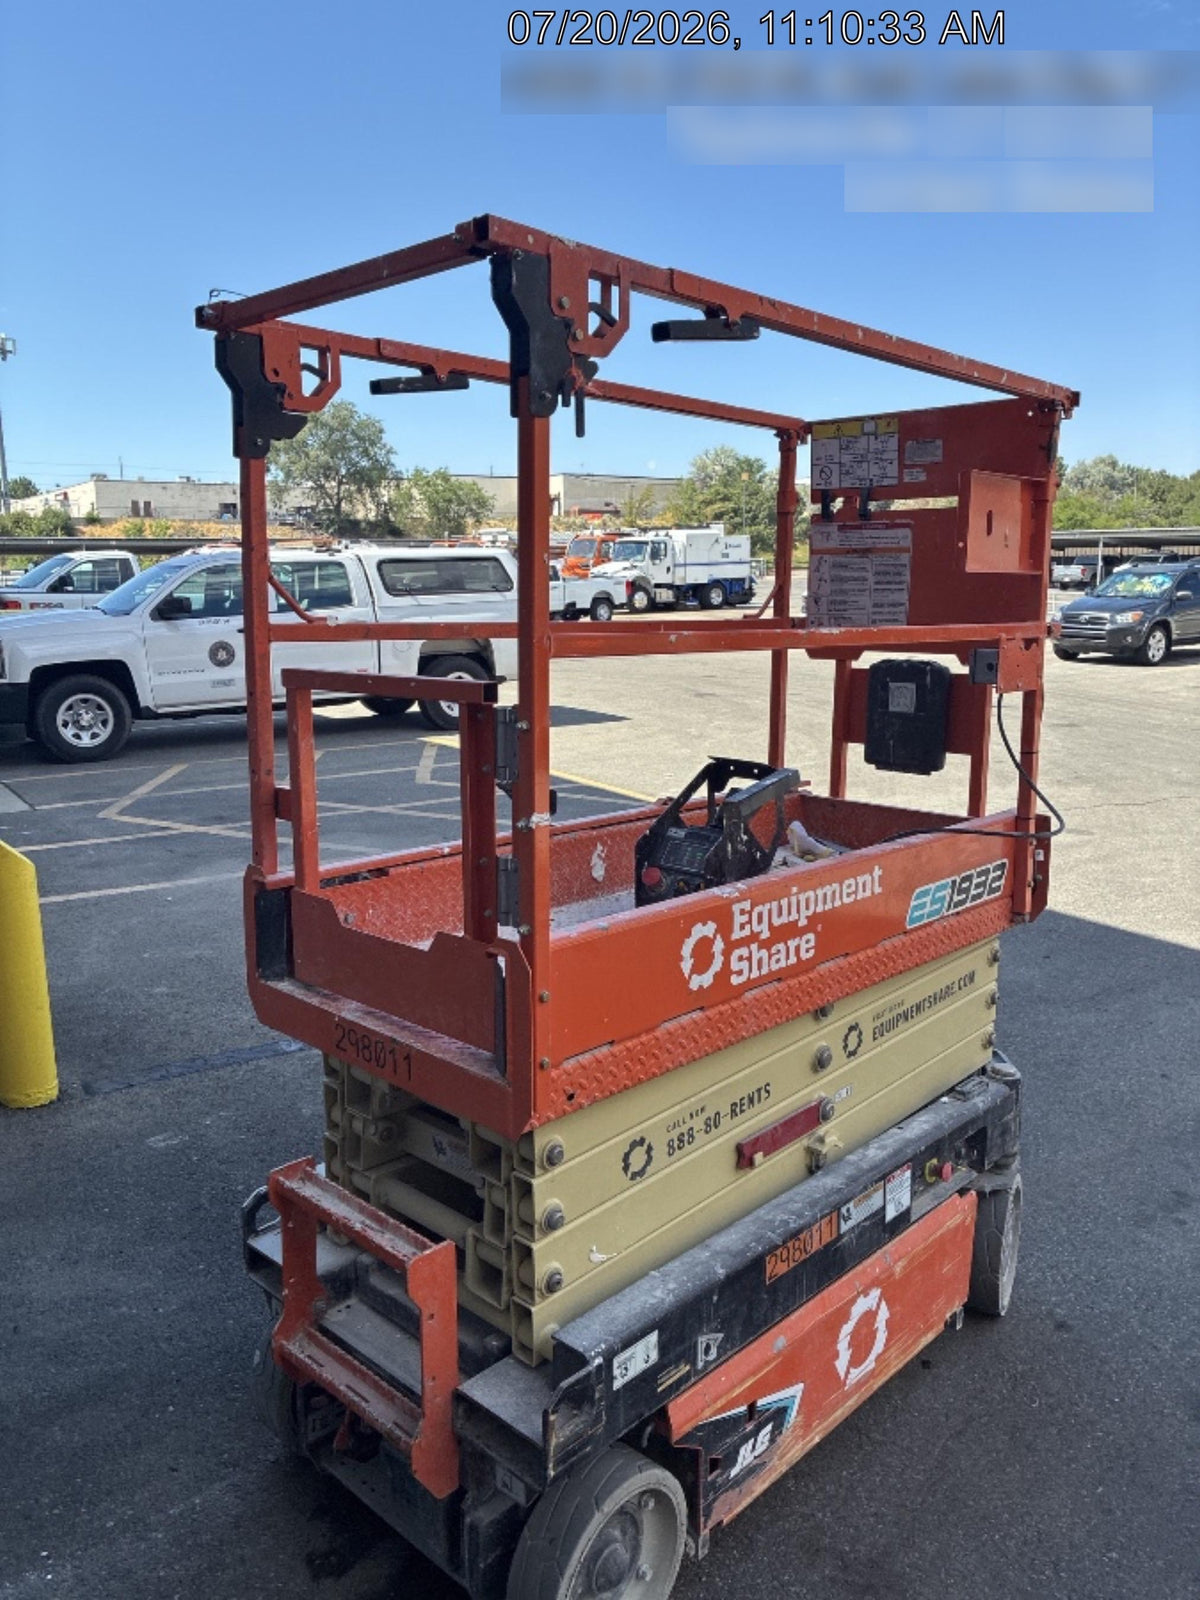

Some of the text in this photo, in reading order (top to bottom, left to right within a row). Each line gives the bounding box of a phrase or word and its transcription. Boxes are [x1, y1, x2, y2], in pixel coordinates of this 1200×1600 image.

[731, 865, 883, 940] Equipment
[907, 858, 1009, 928] ES1932
[730, 931, 816, 987] Share
[335, 1023, 413, 1081] 298011
[667, 1082, 771, 1158] 888-80-RENTS
[768, 1214, 833, 1281] 298011
